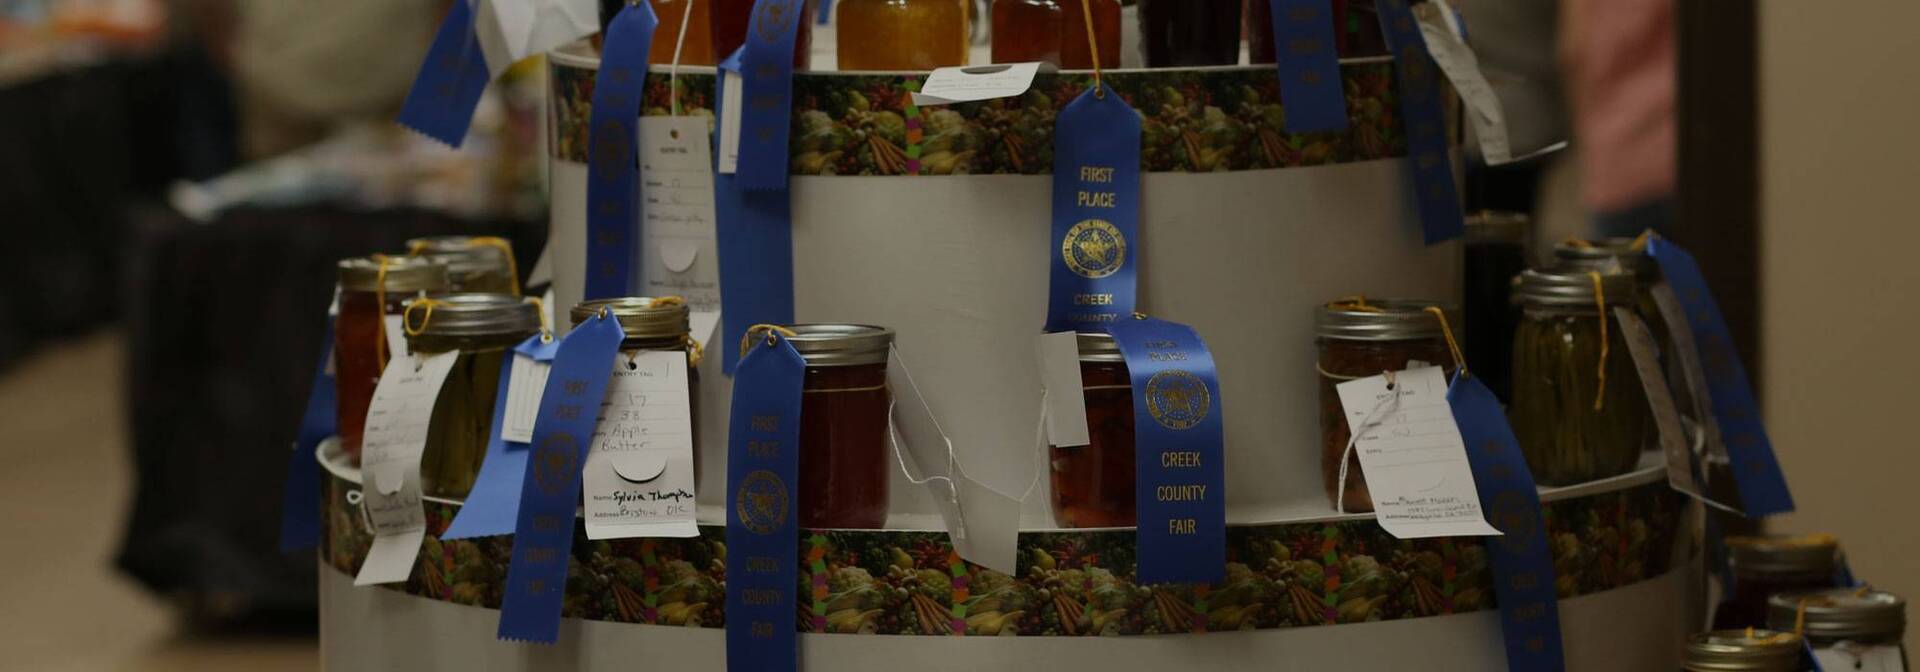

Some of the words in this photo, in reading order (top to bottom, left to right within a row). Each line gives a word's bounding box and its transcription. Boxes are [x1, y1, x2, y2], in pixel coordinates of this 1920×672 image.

[1079, 166, 1115, 183] FIRST
[1077, 191, 1116, 208] PLACE
[1073, 294, 1114, 305] CREEK
[612, 424, 648, 439] Apple
[751, 415, 781, 432] FIRST
[601, 439, 652, 452] Butter
[1161, 451, 1201, 468] CREEK
[613, 491, 646, 506] Sylvia
[1156, 485, 1206, 502] COUNTY
[1168, 518, 1196, 535] FAIR
